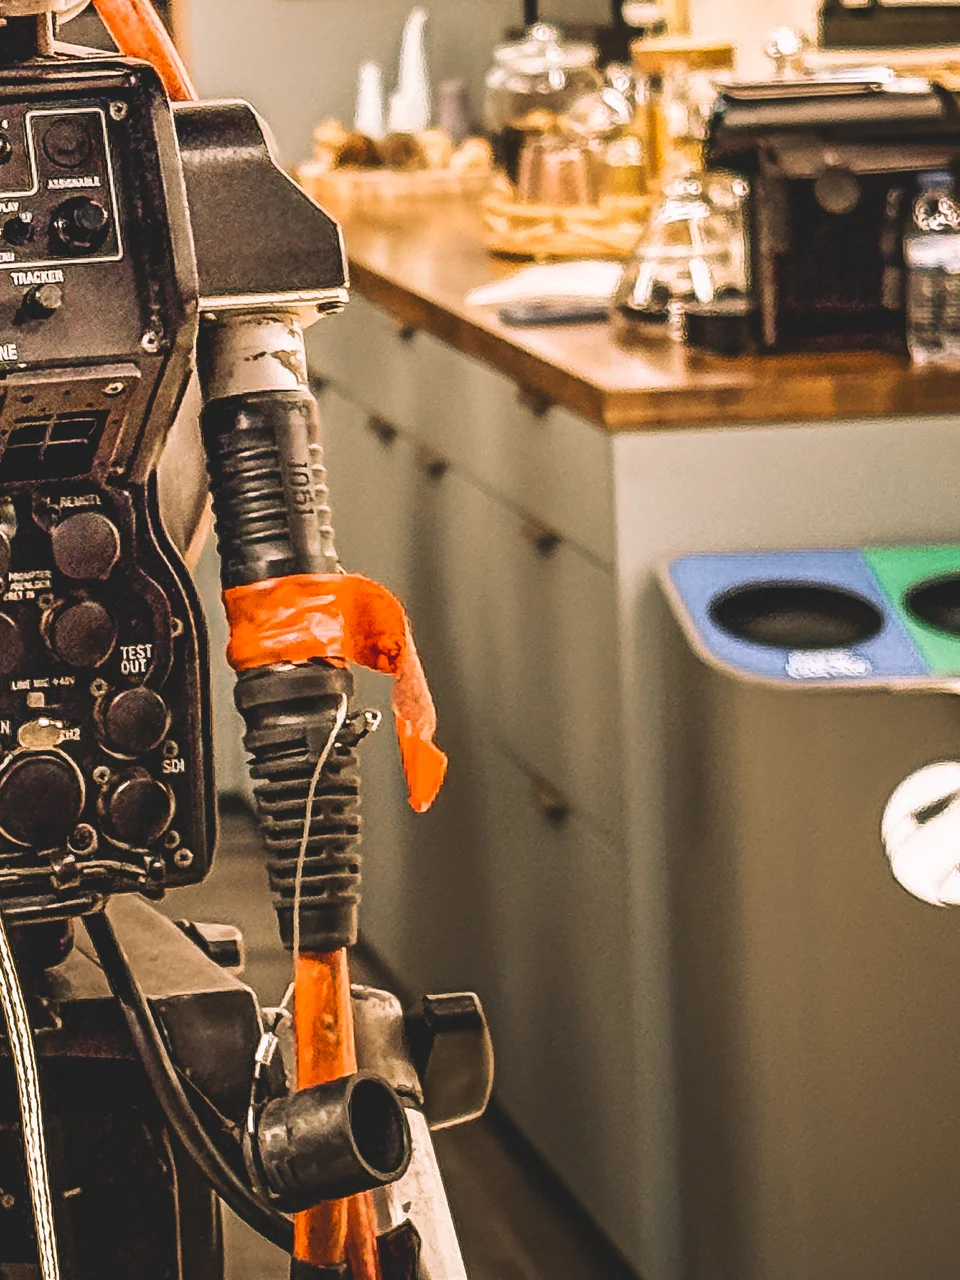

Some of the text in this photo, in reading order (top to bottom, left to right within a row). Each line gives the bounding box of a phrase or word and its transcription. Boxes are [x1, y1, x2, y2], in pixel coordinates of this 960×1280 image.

[11, 270, 64, 285] TRACKER
[120, 644, 153, 660] TEST
[120, 659, 147, 675] OUT
[162, 758, 185, 774] SDI
